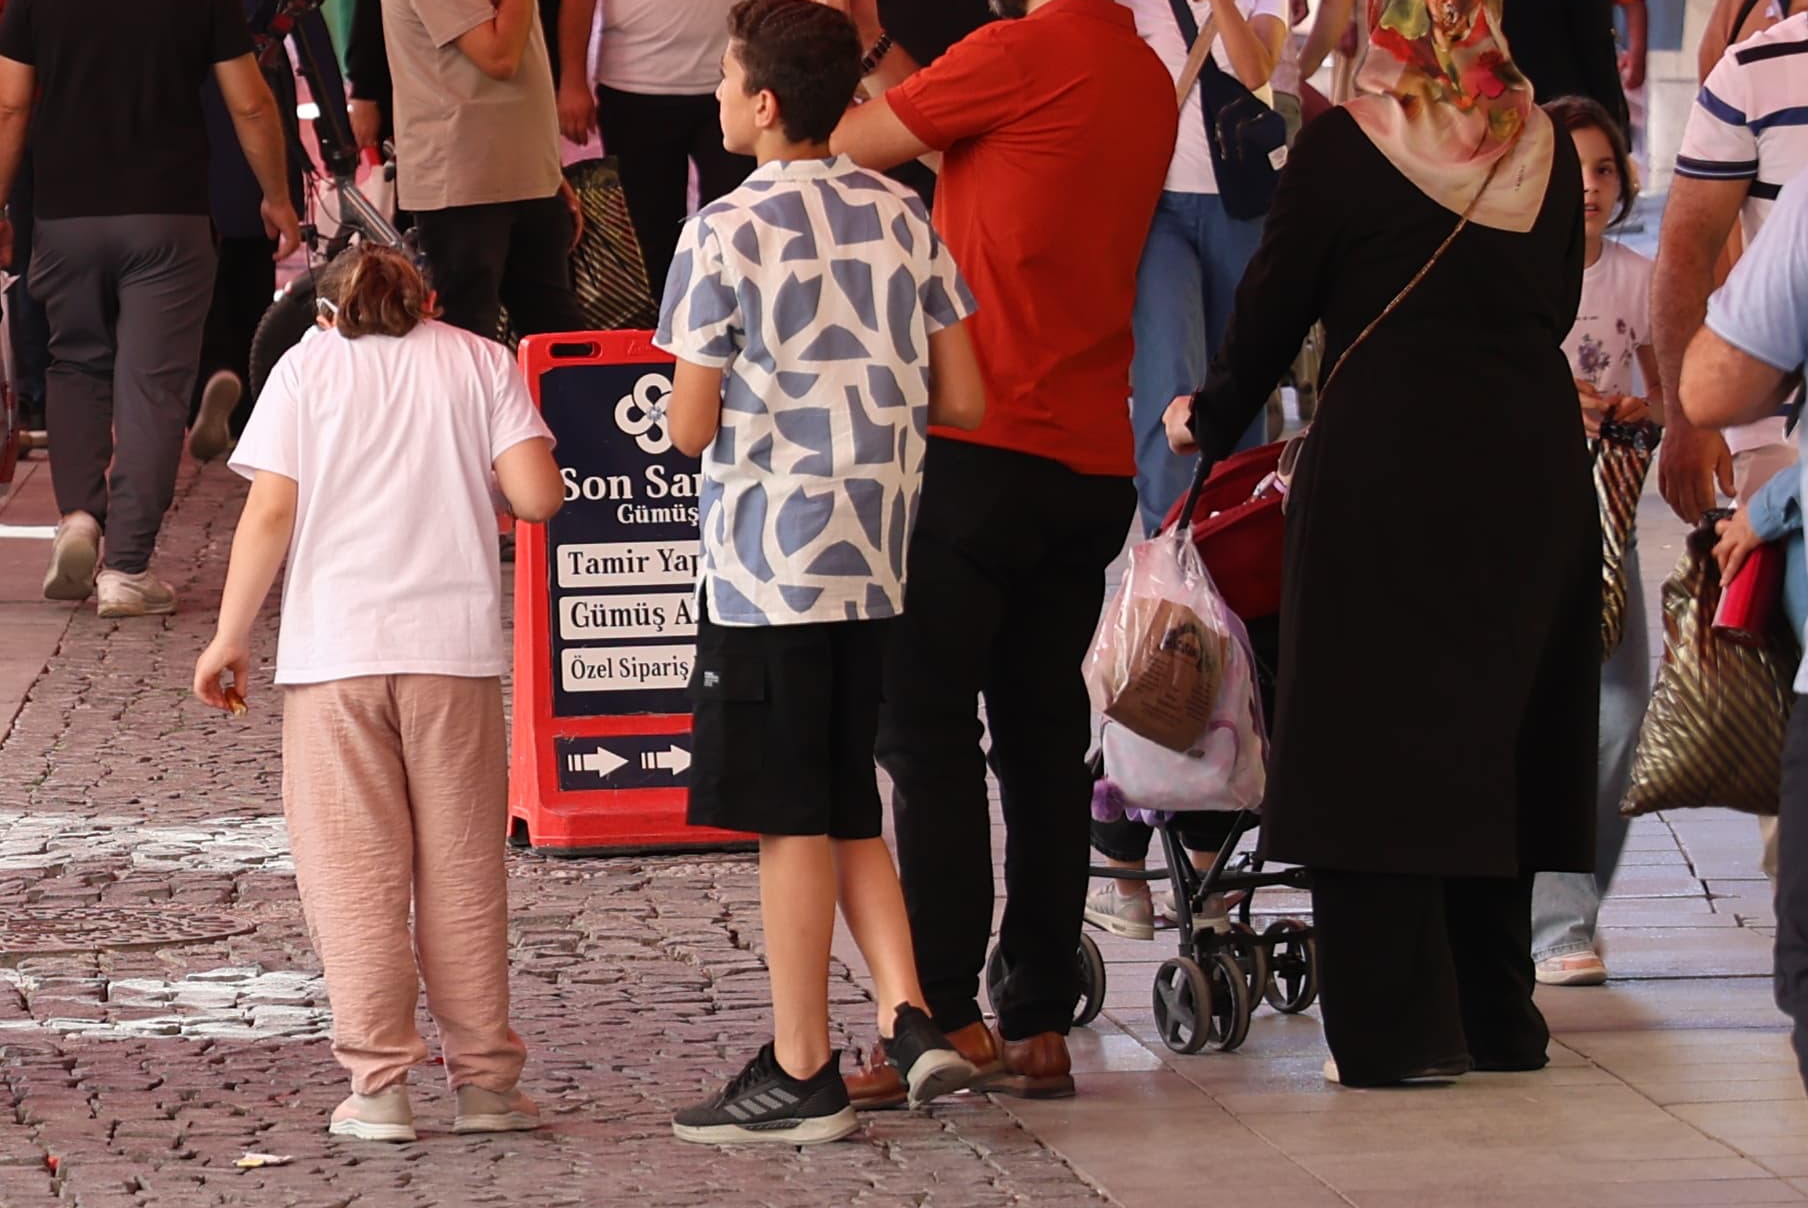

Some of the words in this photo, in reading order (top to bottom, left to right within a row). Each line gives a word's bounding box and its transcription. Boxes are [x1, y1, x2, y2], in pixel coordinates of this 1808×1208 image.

[560, 467, 633, 501] Son
[617, 503, 699, 526] Gümüş
[567, 549, 650, 575] Tamir
[571, 601, 666, 631] Gümüş
[571, 654, 613, 680] Özel
[619, 656, 696, 683] Sipariş
